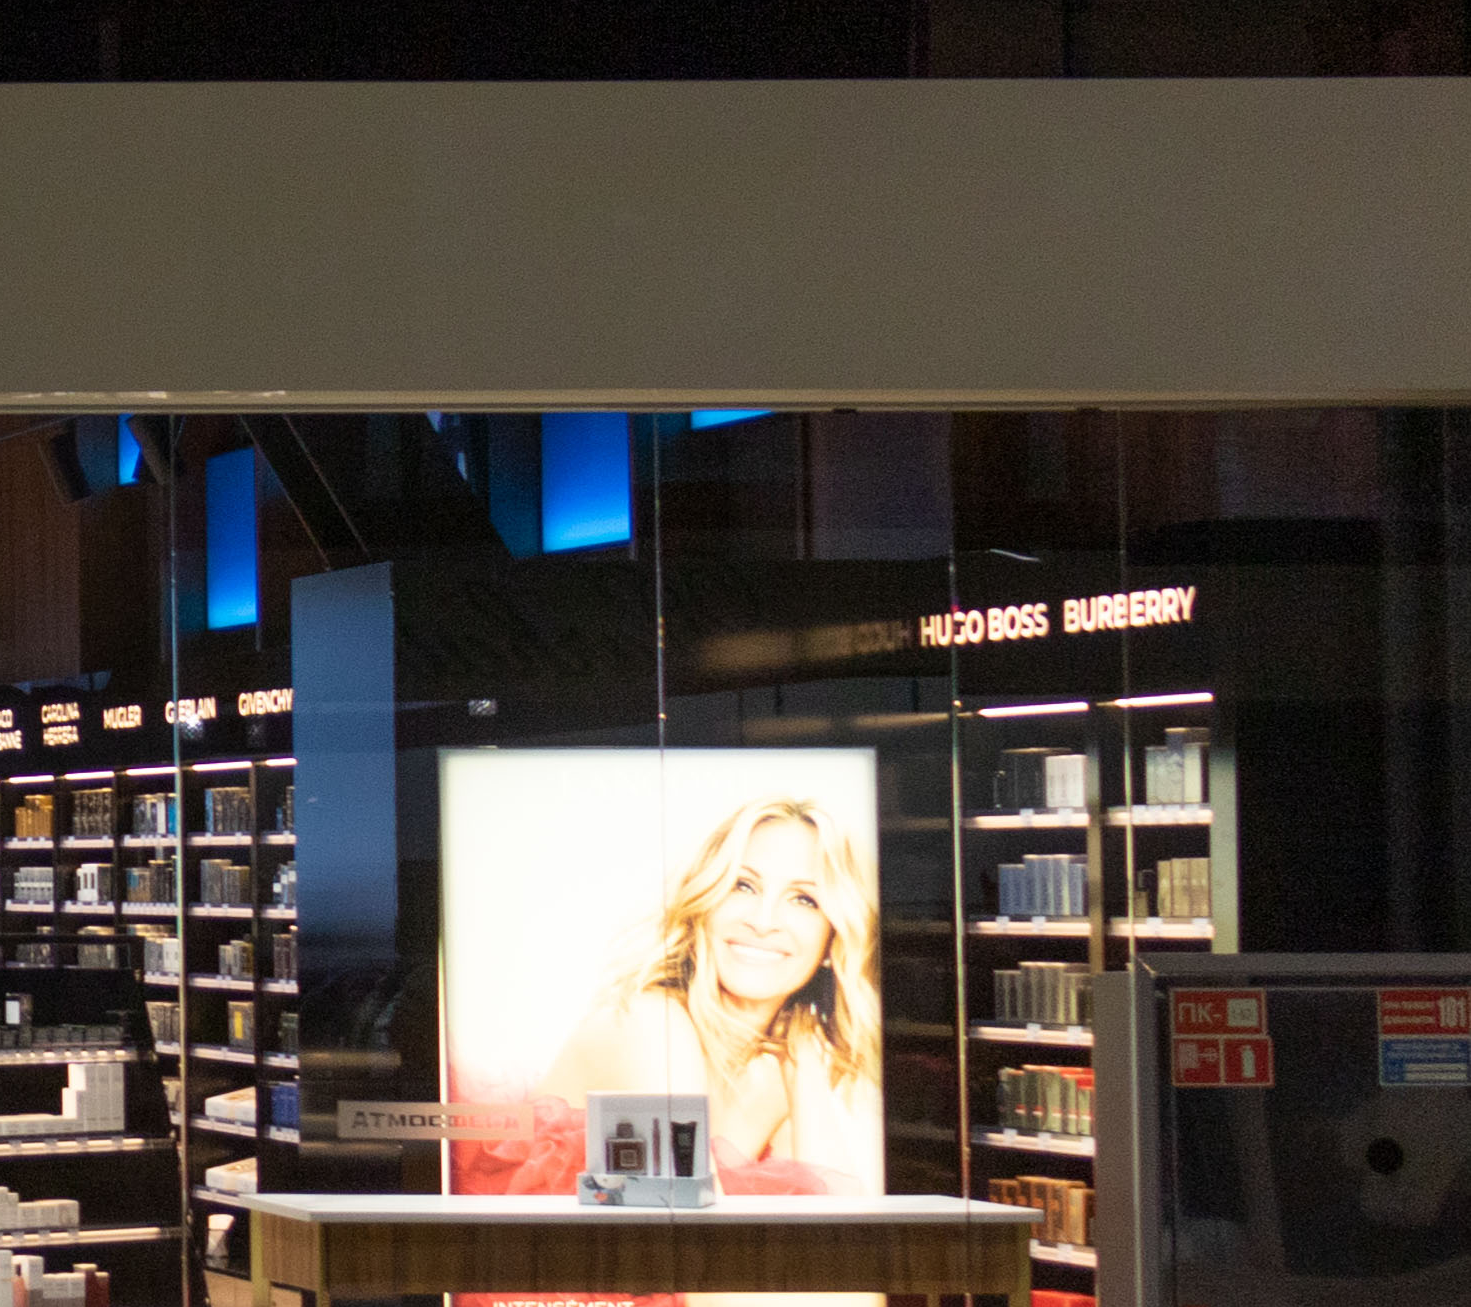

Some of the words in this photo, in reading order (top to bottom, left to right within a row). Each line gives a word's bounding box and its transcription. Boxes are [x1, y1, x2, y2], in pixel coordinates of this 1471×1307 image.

[1063, 585, 1197, 635] BURBERRY
[920, 610, 985, 648] HUGO
[987, 602, 1050, 643] BOSS
[103, 704, 142, 730] MUGLER
[165, 697, 217, 725] GERLAIN
[238, 688, 294, 717] GIVENCHY
